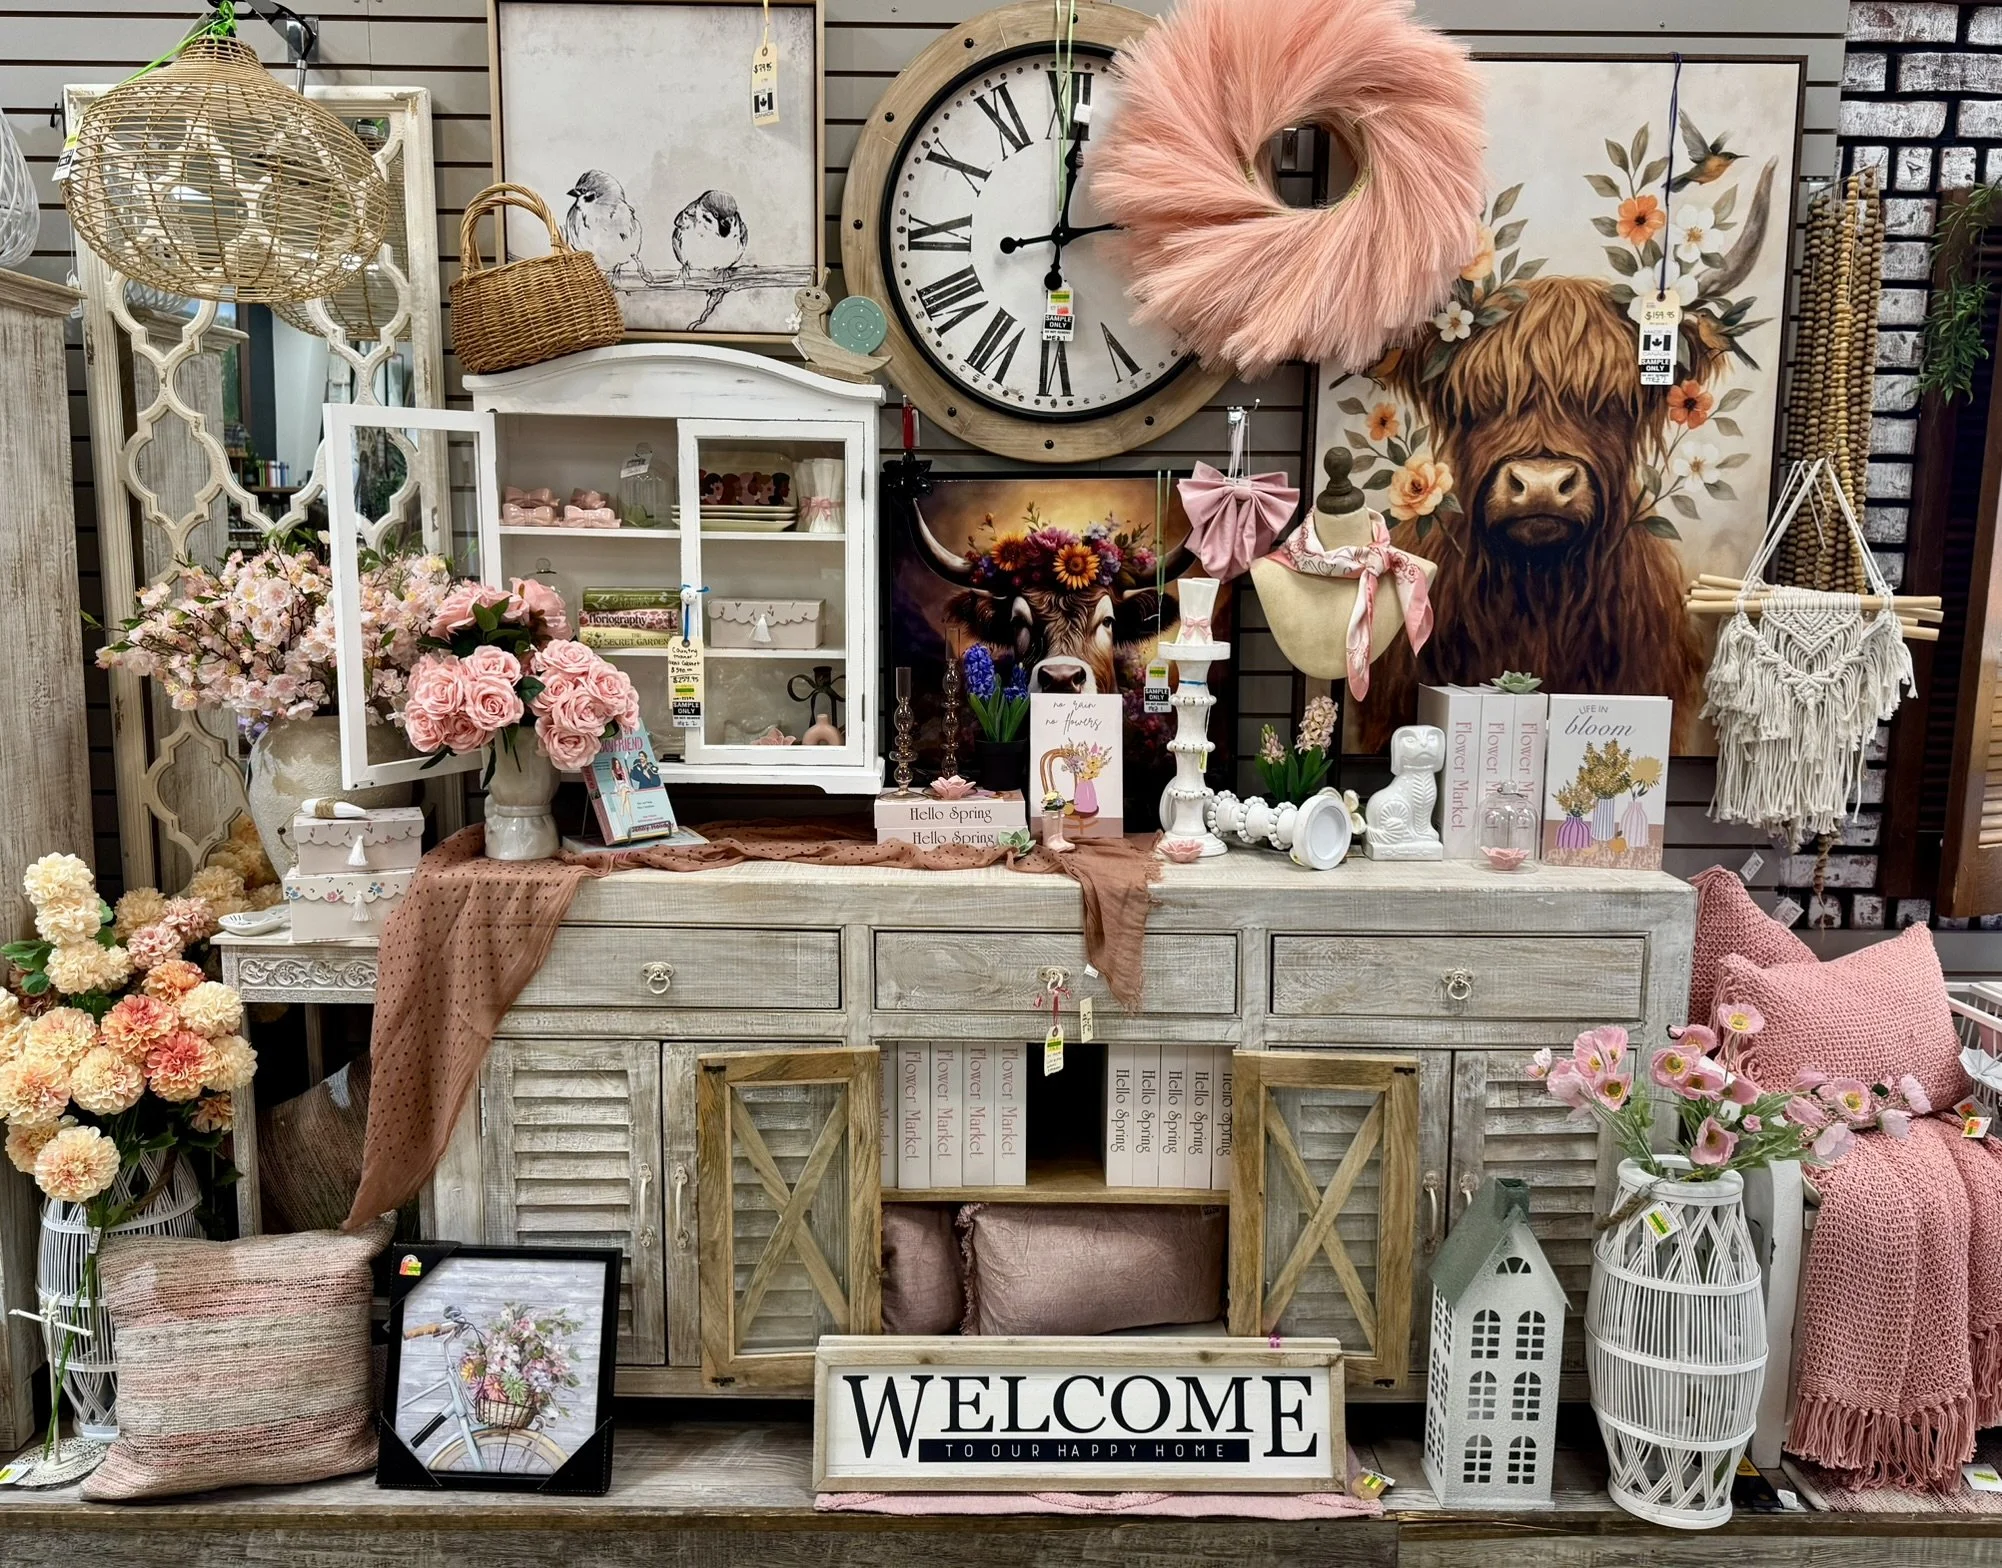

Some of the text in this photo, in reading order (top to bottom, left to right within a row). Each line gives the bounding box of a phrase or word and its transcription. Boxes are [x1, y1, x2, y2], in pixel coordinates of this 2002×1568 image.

[1045, 314, 1072, 322] SAMPLE
[589, 613, 647, 627] floriography
[603, 638, 668, 647] SECRET GARDEN
[1063, 709, 1102, 736] flowers
[1564, 715, 1637, 737] bloom
[1578, 704, 1609, 715] LIFE IN
[1486, 722, 1504, 774] Flower
[1518, 722, 1538, 775] Flower
[1450, 721, 1473, 832] Flower Market
[910, 806, 992, 824] Hello Spring
[913, 830, 995, 847] Hello Spring
[905, 1051, 922, 1161] Flower Market
[937, 1049, 954, 1160] Flower Market
[969, 1047, 987, 1159] Flower Market
[1001, 1047, 1018, 1159] Flower Market
[1110, 1069, 1130, 1152] Hello Spring
[1136, 1070, 1156, 1153] Hello Spring
[1162, 1071, 1183, 1154] Hello Spring
[1188, 1072, 1209, 1155] Hello Spring
[843, 1375, 1318, 1459] WELCOME
[945, 1444, 1224, 1458] TO OUR HAPPY HOME
